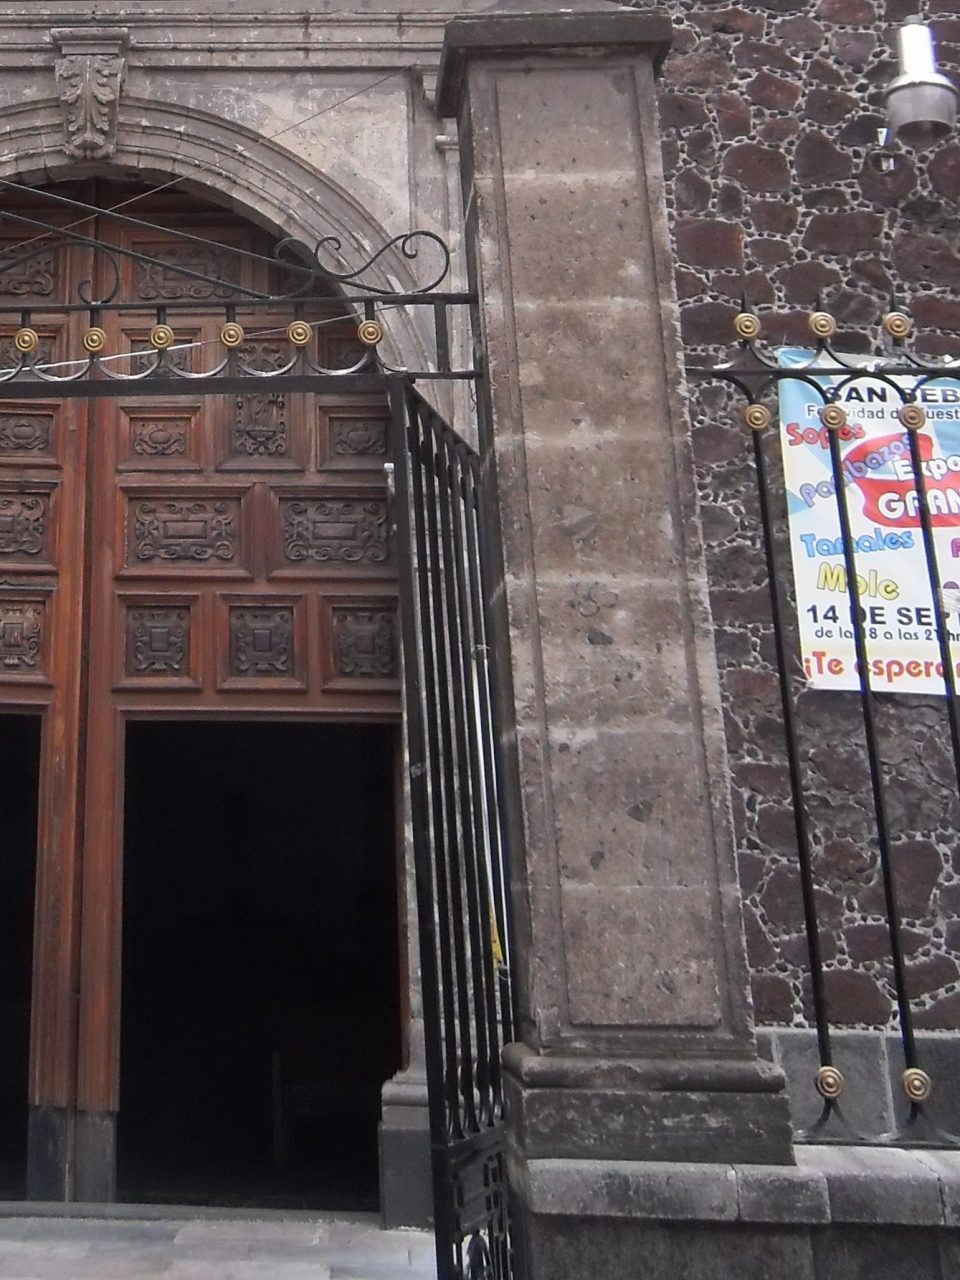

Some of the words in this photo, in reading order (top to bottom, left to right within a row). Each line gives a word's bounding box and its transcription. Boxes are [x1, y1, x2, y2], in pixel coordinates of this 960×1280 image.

[824, 386, 887, 403] SAN
[786, 422, 865, 450] Sopes
[800, 528, 915, 558] Tamales
[817, 561, 900, 601] Mole
[806, 604, 840, 624] 14
[814, 626, 834, 638] de
[883, 631, 894, 640] a
[898, 628, 920, 640] las
